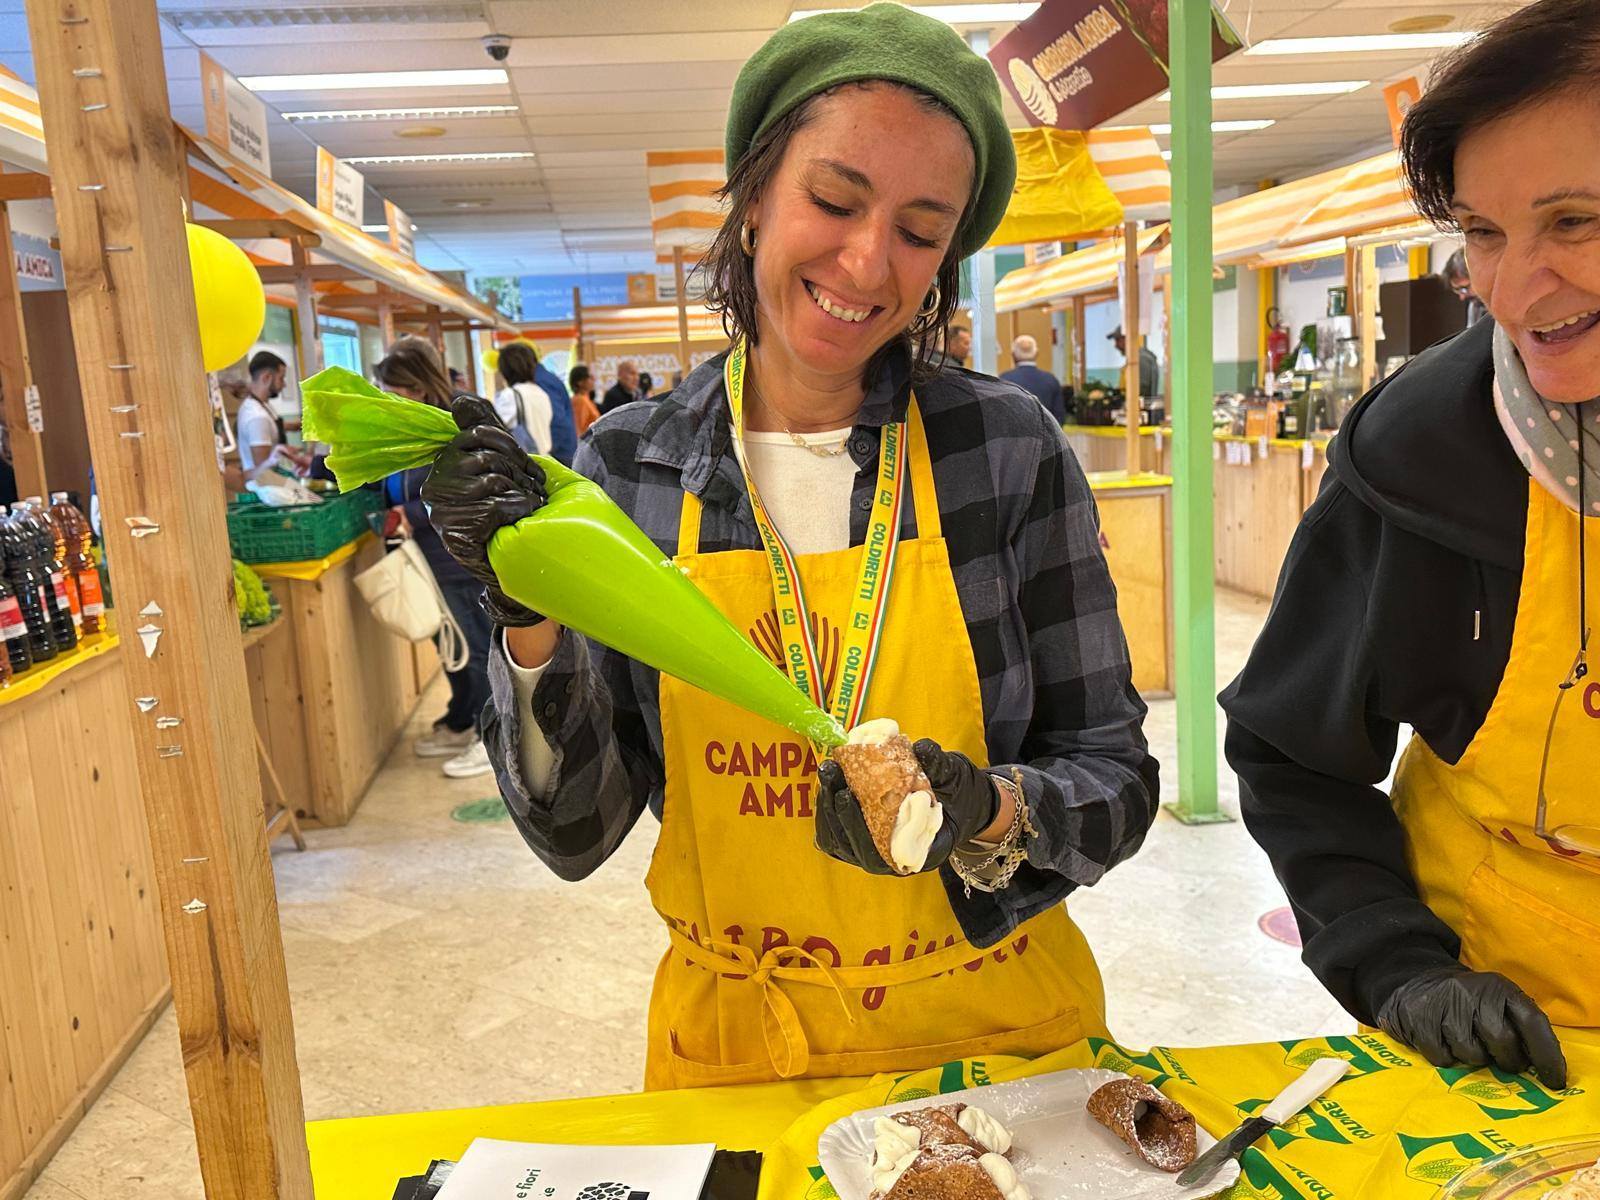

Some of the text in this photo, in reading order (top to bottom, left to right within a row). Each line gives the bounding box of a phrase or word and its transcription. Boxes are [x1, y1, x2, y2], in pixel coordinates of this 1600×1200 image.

[761, 523, 790, 595] COLDIRETTI
[860, 522, 887, 600] COLDIRETTI
[705, 741, 817, 777] CAMPA
[739, 782, 813, 817] AMI
[516, 1168, 541, 1189] fiori
